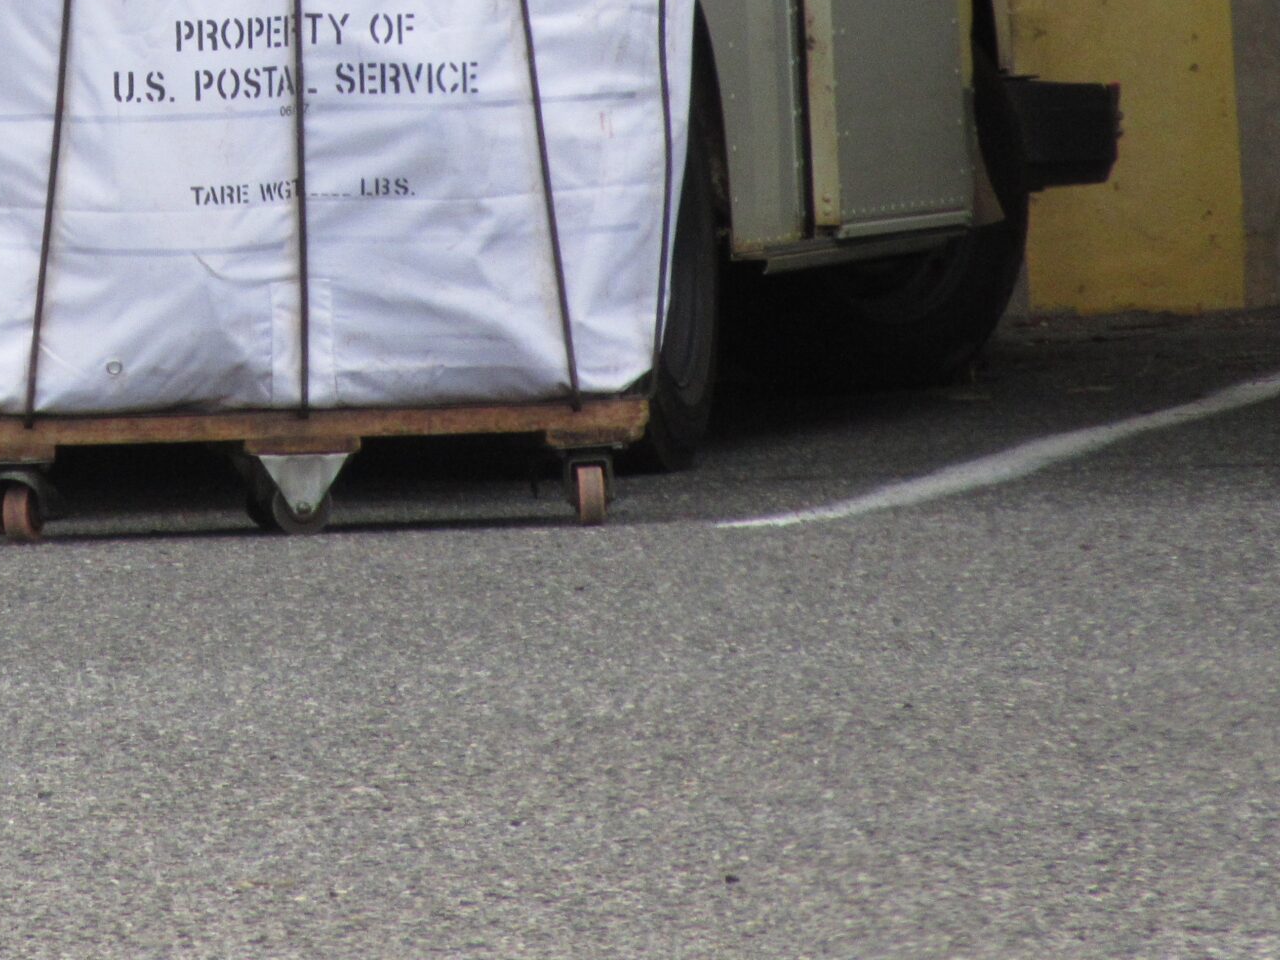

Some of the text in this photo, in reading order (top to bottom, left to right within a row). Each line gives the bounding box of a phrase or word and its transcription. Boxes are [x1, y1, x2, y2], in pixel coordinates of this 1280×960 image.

[369, 13, 415, 45] OF
[113, 70, 175, 103] U.S.
[335, 61, 479, 95] SERVICE
[190, 183, 250, 206] TARE
[360, 176, 417, 197] LBS.
